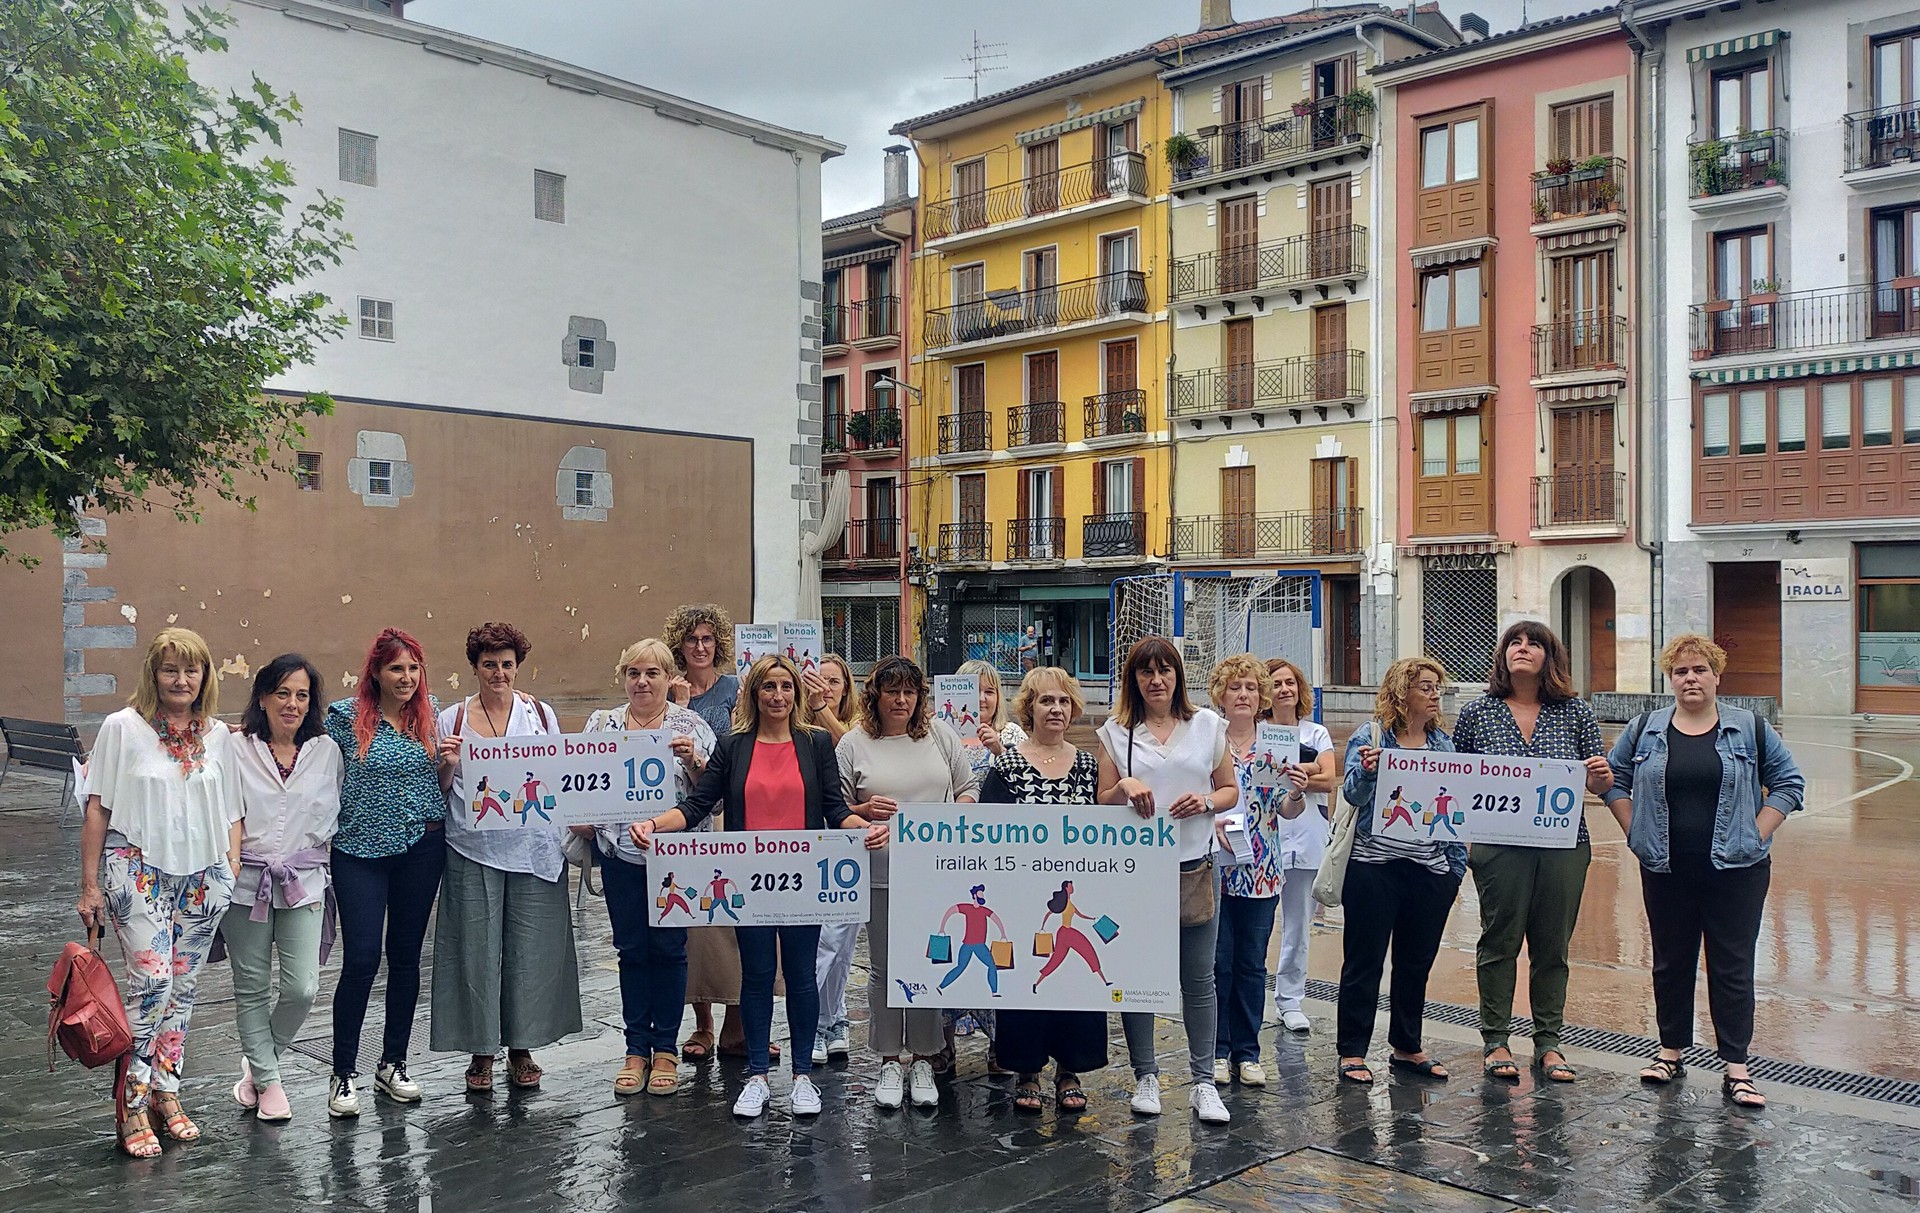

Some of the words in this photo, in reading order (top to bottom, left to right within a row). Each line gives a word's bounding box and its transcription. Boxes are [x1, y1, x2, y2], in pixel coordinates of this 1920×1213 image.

[1576, 553, 1588, 561] 35
[1742, 548, 1754, 557] 37
[1787, 585, 1843, 596] IRAOLA
[740, 630, 773, 640] bonoak
[783, 626, 817, 636] bonoak
[940, 681, 974, 691] bonoak
[1262, 730, 1295, 742] bonoak
[469, 740, 557, 761] kontsumo
[563, 739, 618, 755] bonoa
[1387, 754, 1473, 775] kontsumo
[1480, 758, 1532, 779] bonoa
[560, 772, 611, 792] 2023
[623, 757, 666, 789] 10
[625, 787, 664, 801] euro
[1471, 793, 1521, 814] 2023
[1535, 784, 1576, 815] 10
[1533, 814, 1570, 829] euro
[898, 813, 1049, 845] kontsumo
[1062, 815, 1176, 847] bonoak
[654, 838, 747, 856] kontsumo
[754, 836, 811, 855] bonoa
[936, 855, 988, 871] irailak
[994, 856, 1016, 872] 15
[1031, 857, 1119, 873] abenduak
[1124, 858, 1136, 874] 9
[750, 872, 803, 893] 2023
[816, 858, 861, 891] 10
[817, 889, 859, 903] euro
